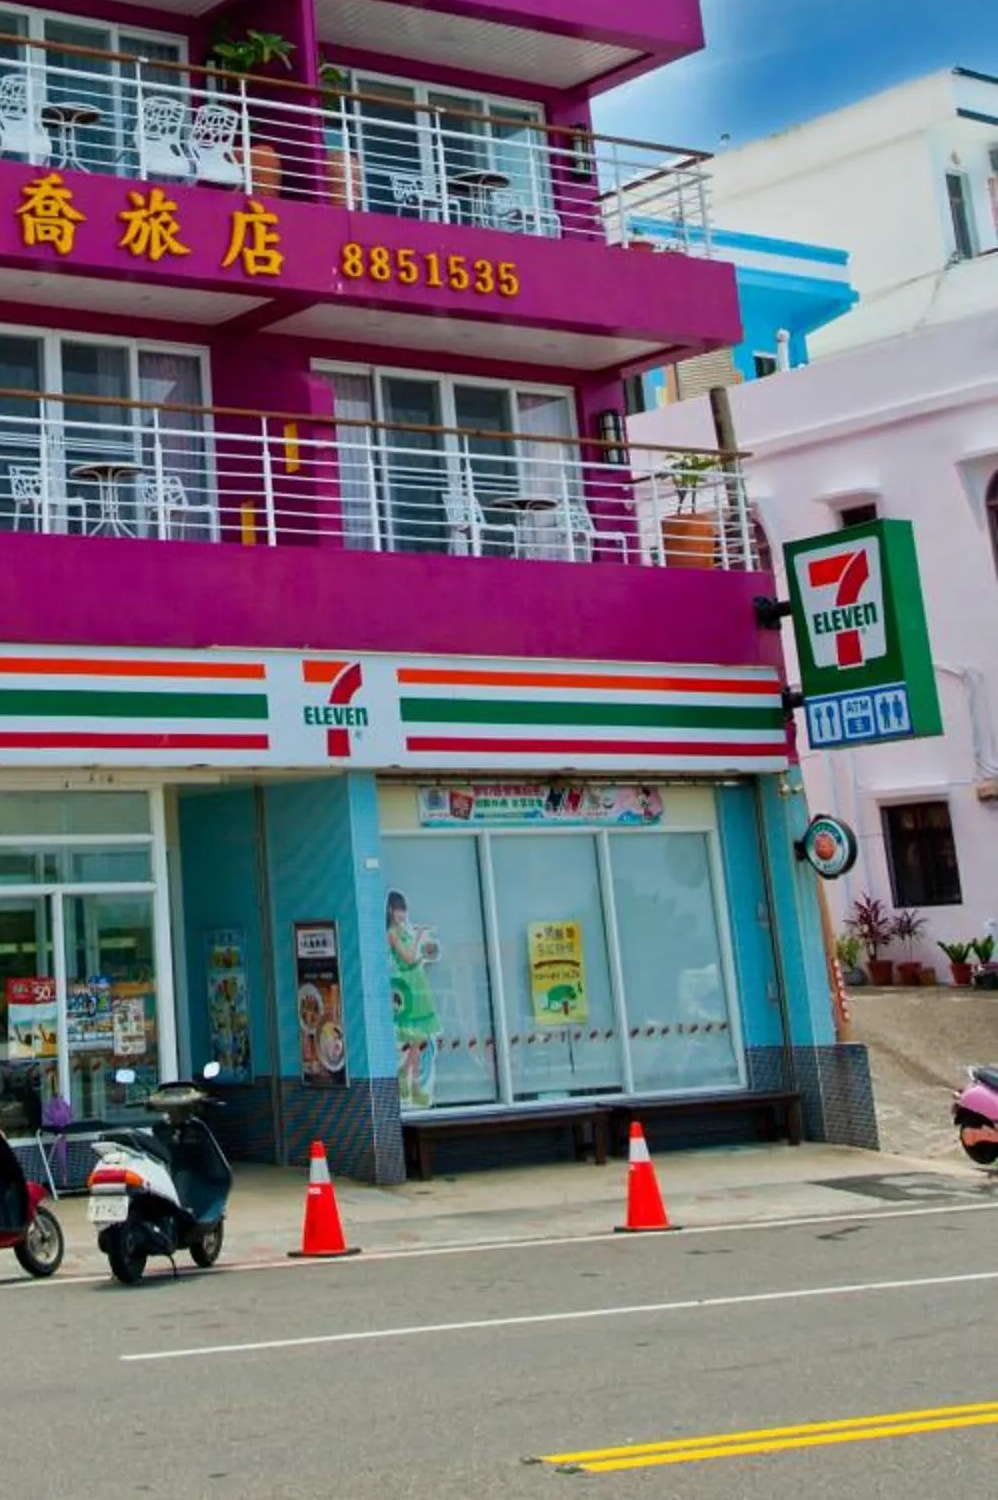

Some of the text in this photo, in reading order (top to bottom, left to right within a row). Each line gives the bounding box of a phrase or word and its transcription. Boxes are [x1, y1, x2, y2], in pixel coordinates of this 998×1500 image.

[341, 241, 521, 297] 8851535
[808, 549, 869, 667] 7
[303, 660, 363, 757] 7
